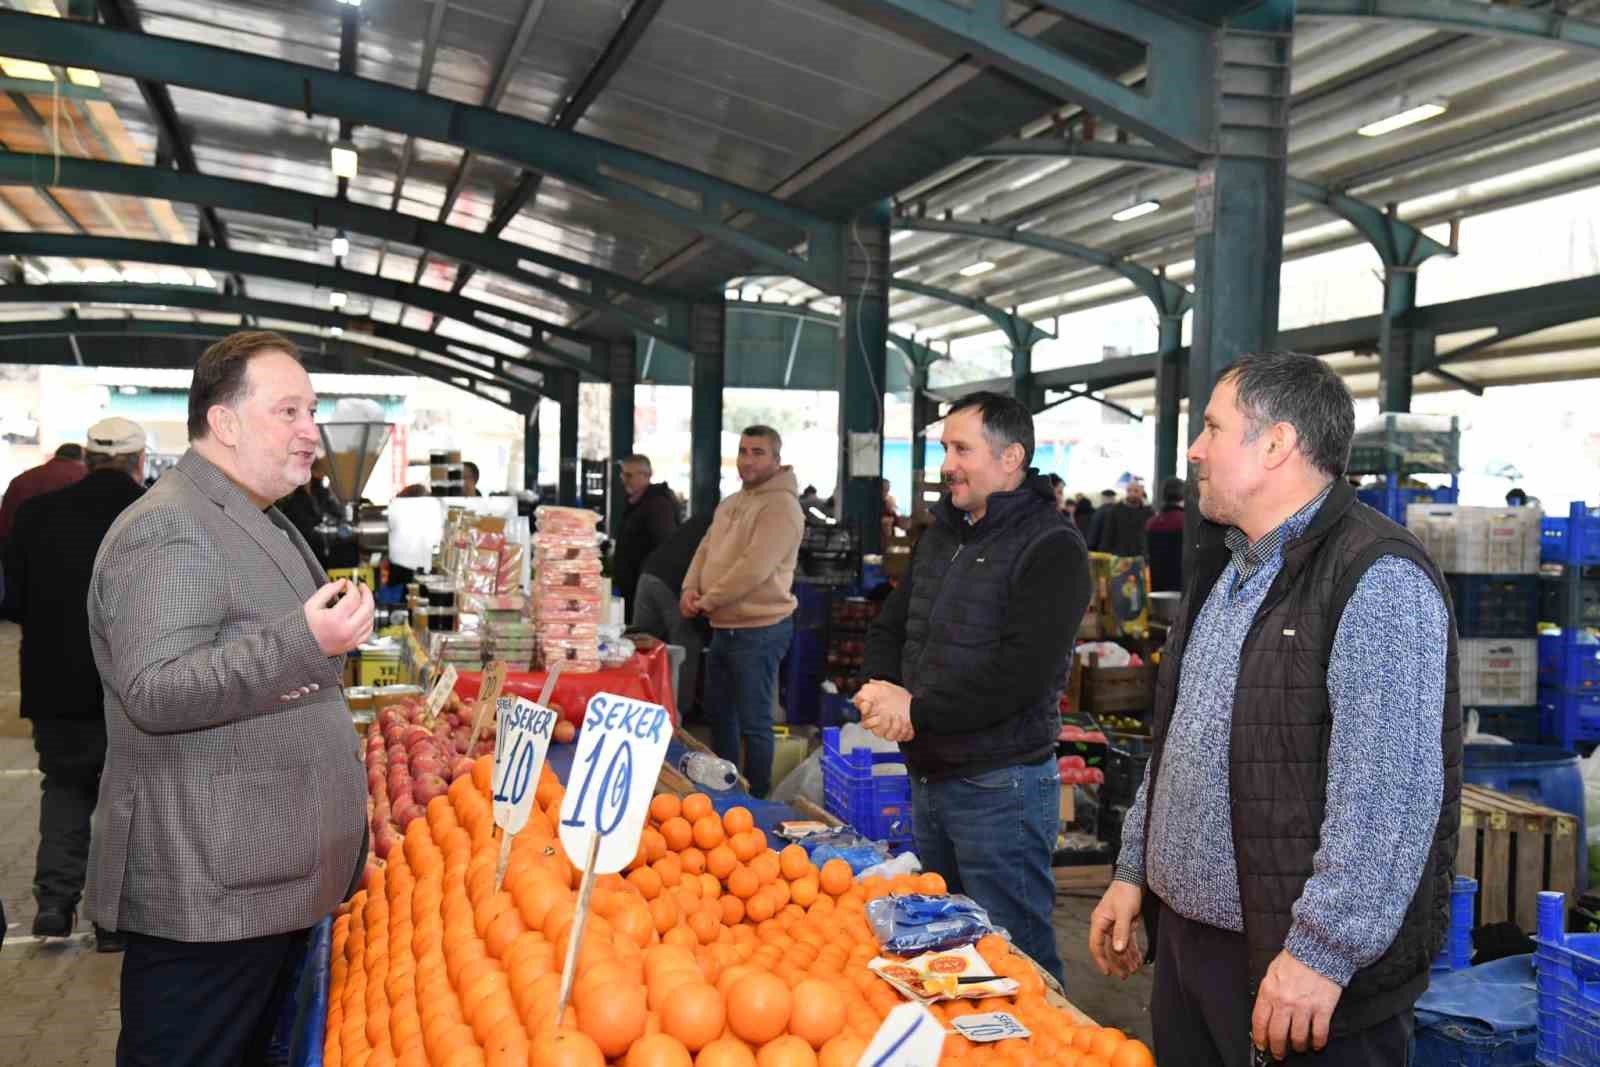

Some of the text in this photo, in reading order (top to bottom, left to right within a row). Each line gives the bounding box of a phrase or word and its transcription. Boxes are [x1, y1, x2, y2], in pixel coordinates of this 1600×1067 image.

[510, 703, 553, 740] ŞEKER
[586, 696, 667, 744] ŞEKER
[494, 730, 534, 805] 10
[561, 733, 633, 837] 10
